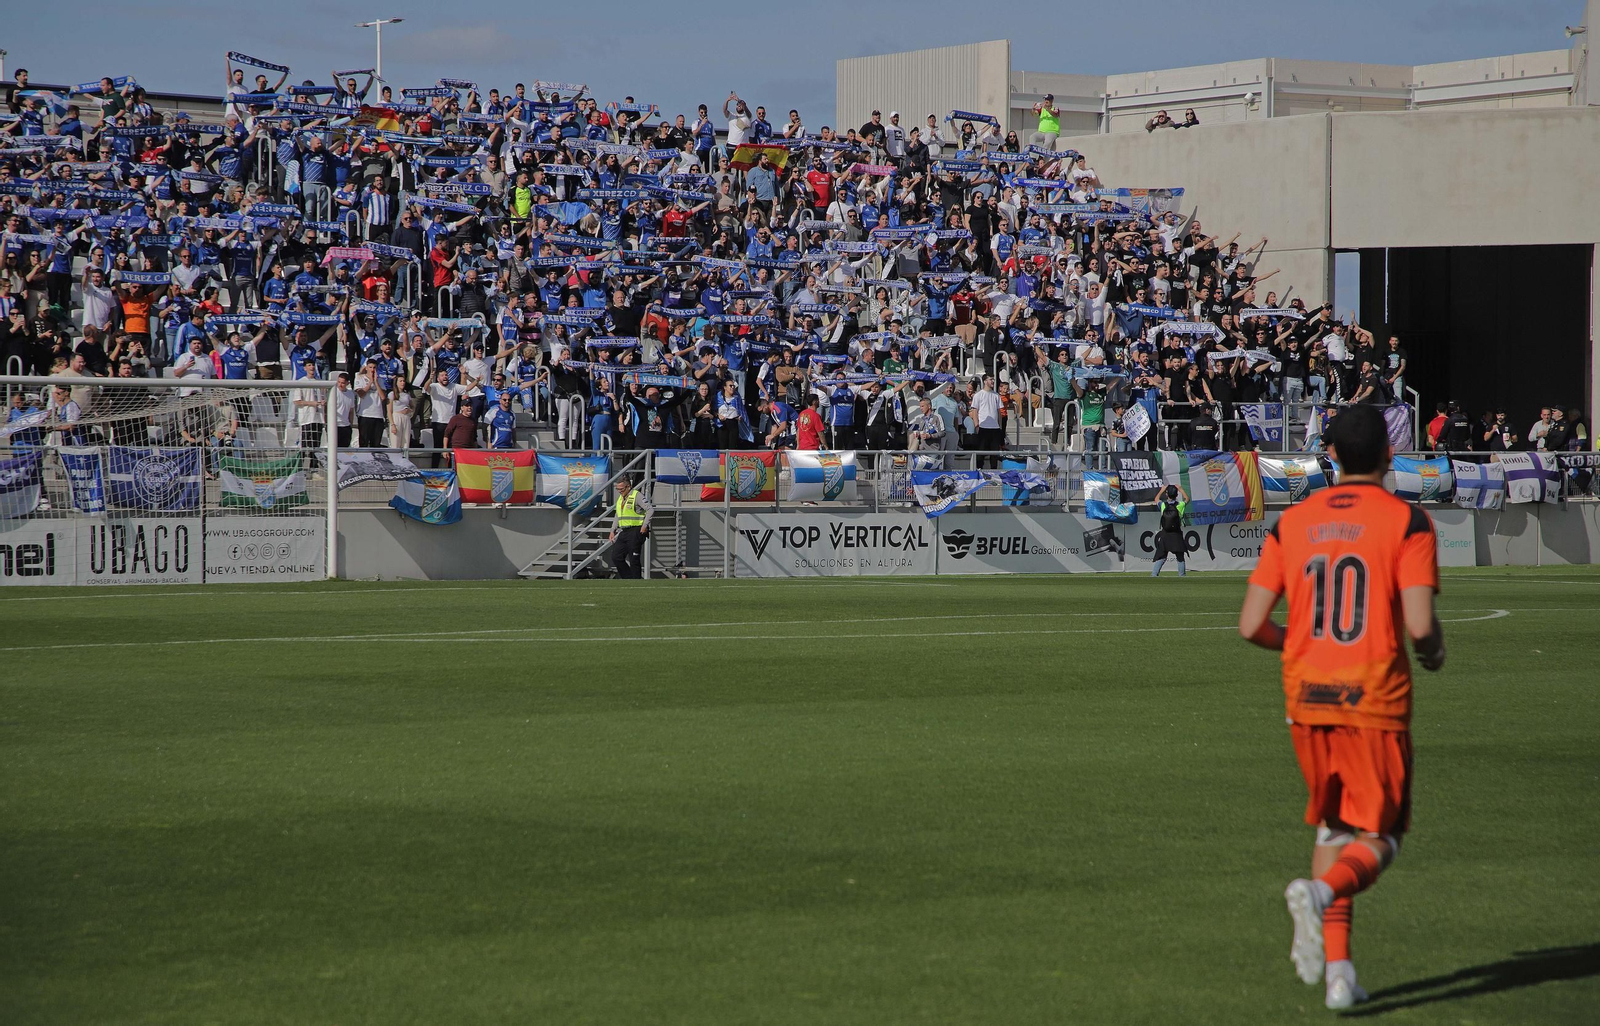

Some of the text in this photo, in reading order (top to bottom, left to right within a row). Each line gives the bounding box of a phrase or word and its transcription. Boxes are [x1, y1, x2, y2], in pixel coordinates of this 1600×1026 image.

[406, 88, 449, 97] XEREZ CD
[116, 127, 158, 136] XEREZ CD
[593, 190, 622, 198] XEREZ
[1098, 188, 1118, 196] XERE
[140, 234, 167, 243] XEREZ
[537, 256, 577, 266] XEREZ CD
[122, 272, 151, 283] XEREZ
[662, 307, 685, 316] XEREZ
[548, 315, 592, 325] XEREZ CD
[724, 315, 768, 323] XEREZ CD
[1176, 323, 1213, 332] XEREZ
[642, 375, 667, 385] XEREZ
[1120, 458, 1150, 470] FABIO
[1118, 470, 1159, 480] SIEMPRE
[1184, 511, 1208, 519] ESDE
[779, 521, 929, 551] TOP VERTICAL
[1229, 524, 1272, 539] Contig
[976, 536, 1080, 556] BFUEL Gasolineras
[1443, 539, 1472, 548] Center
[90, 524, 189, 575] UBAGO
[1230, 545, 1255, 558] con
[795, 558, 913, 568] SOLUCIONES EN ALTURA
[206, 564, 315, 575] NUEVA TIENDA ONLINE
[1304, 553, 1370, 646] 10
